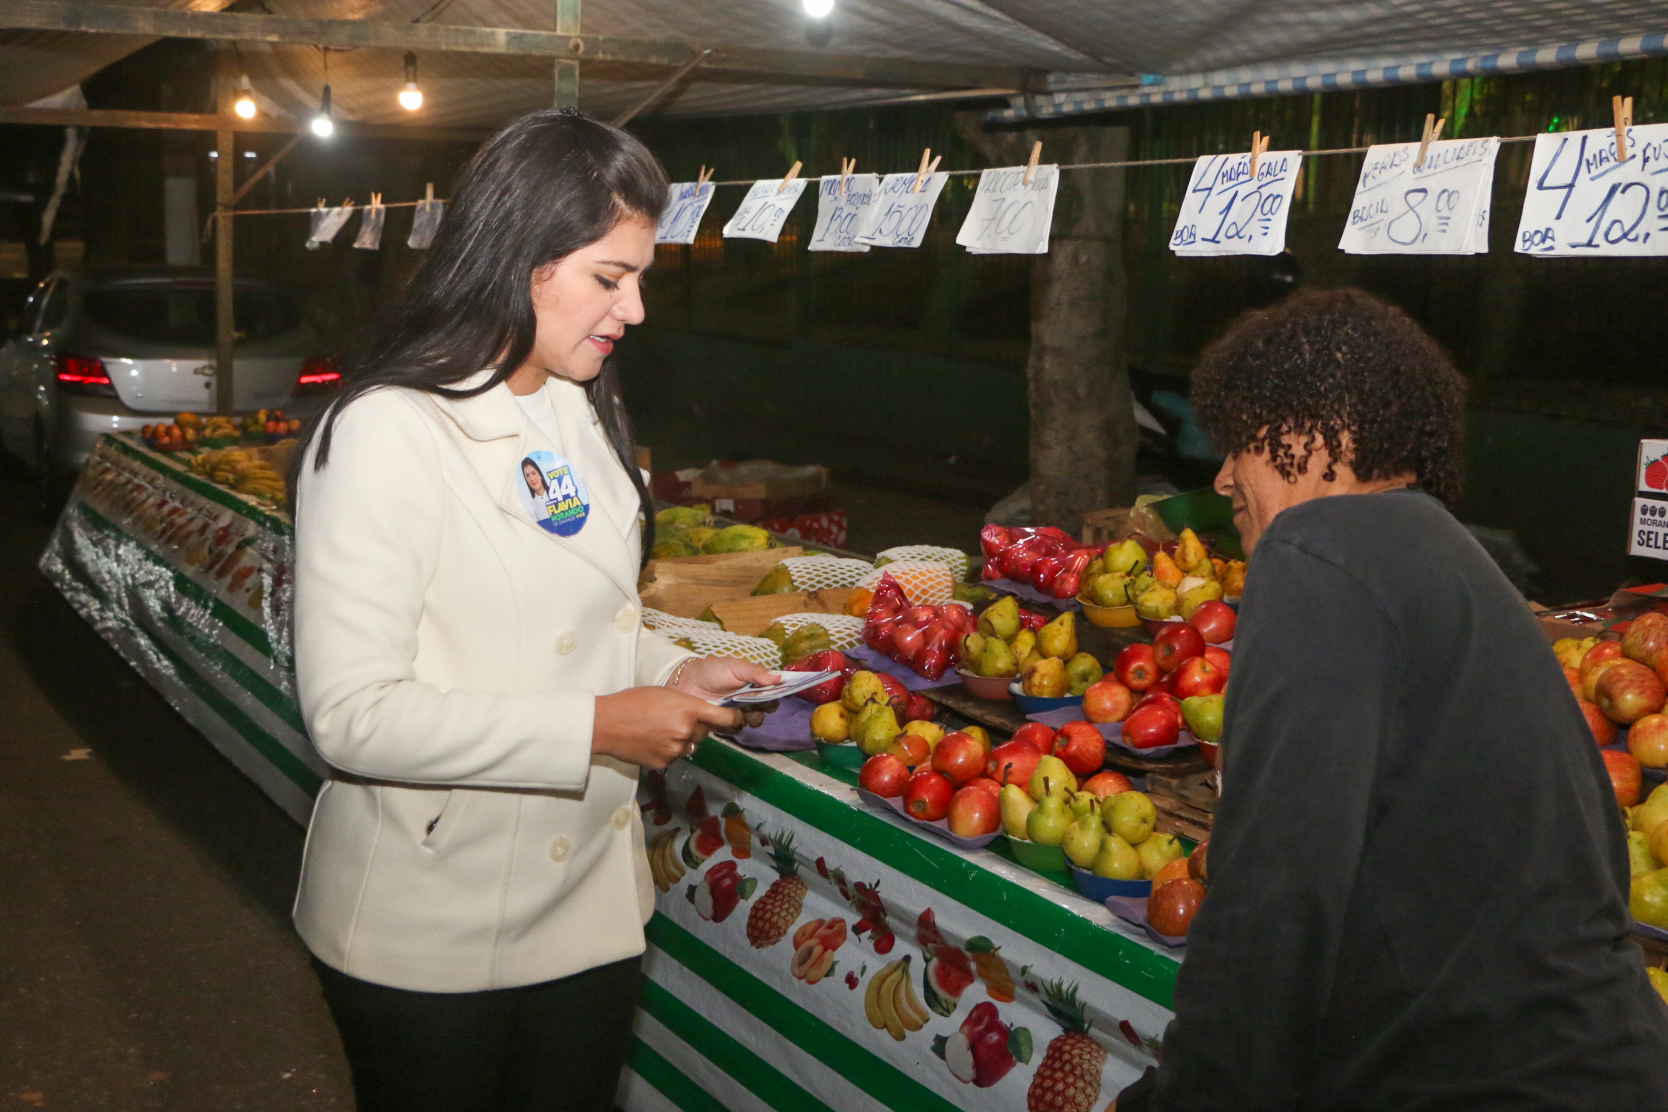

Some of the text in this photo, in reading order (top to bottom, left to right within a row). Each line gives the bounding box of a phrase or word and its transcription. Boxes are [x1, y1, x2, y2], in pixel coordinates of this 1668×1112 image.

[1192, 155, 1229, 214] 4
[1257, 157, 1287, 182] GALA
[1536, 135, 1588, 220] 4
[1585, 128, 1636, 174] MAÇS
[547, 466, 570, 480] VOTE
[549, 474, 577, 502] 44
